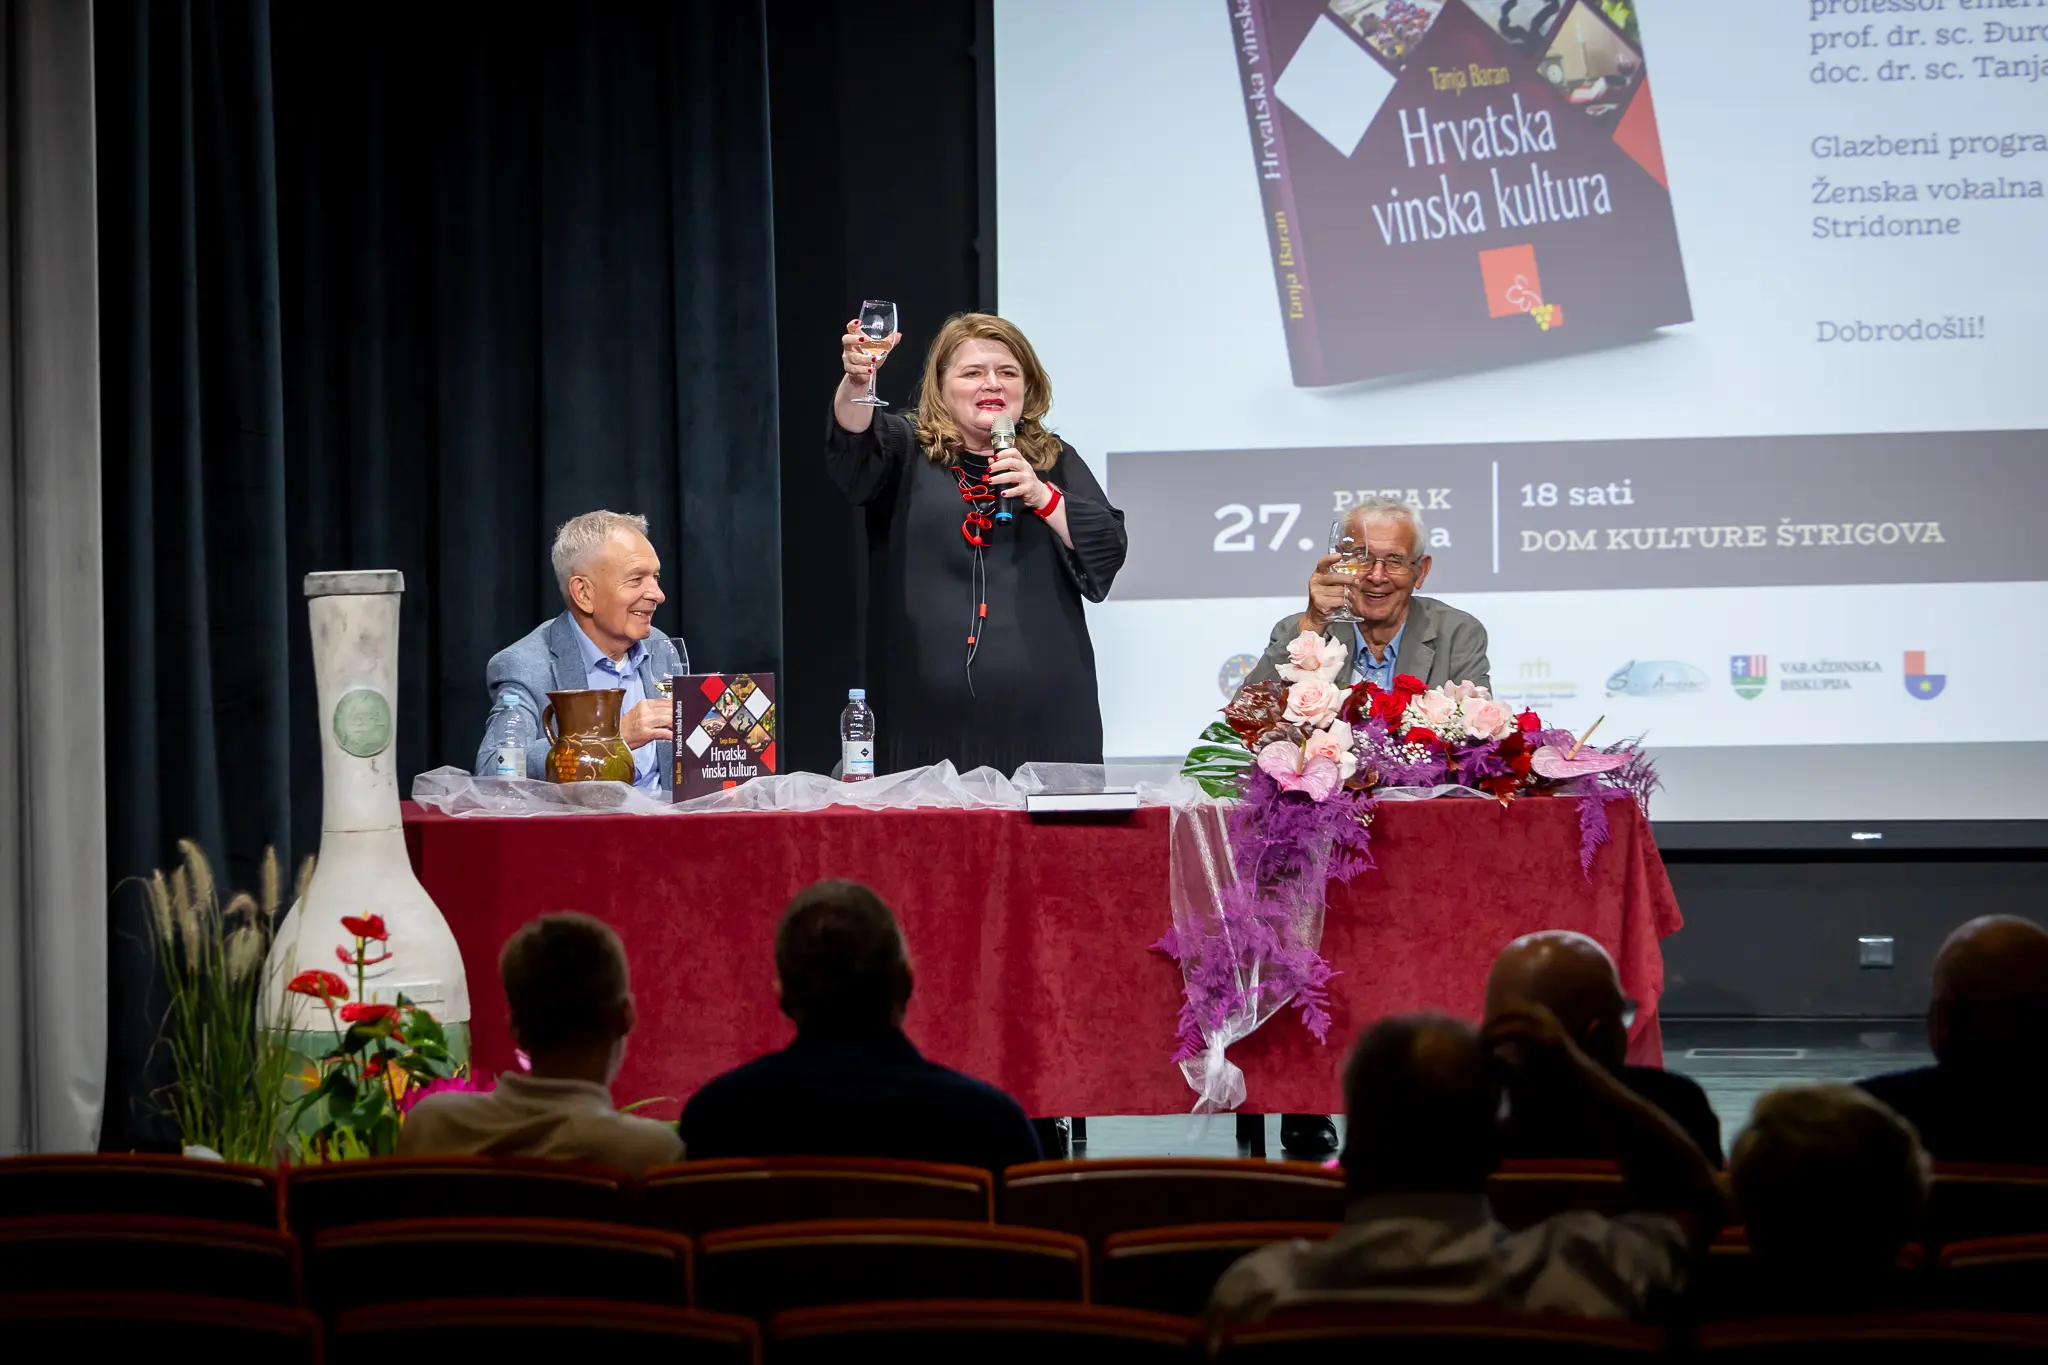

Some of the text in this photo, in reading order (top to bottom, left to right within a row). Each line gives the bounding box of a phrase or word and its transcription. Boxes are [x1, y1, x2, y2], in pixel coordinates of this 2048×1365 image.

[1809, 0, 1946, 21] professor
[1810, 25, 1878, 55] prof.
[1887, 25, 1926, 46] dr.
[1935, 27, 1974, 45] sc.
[1427, 63, 1510, 96] Tanja Baran
[1810, 62, 1868, 83] doc.
[1877, 60, 1916, 81] dr.
[1925, 61, 1964, 80] sc.
[1235, 0, 1281, 179] Hrvatska vinsk
[1398, 93, 1557, 168] Hrvatska
[1811, 133, 2048, 160] Glazbeni progra
[1811, 176, 2045, 204] Ženska vokalna
[1372, 163, 1613, 246] vinska kultura
[1274, 211, 1295, 266] Baran
[1812, 214, 1961, 239] Stridonne
[1816, 315, 1985, 343] Dobrodošli!
[1520, 479, 1635, 507] 18 sati
[1213, 503, 1314, 552] 27.
[1520, 518, 1946, 552] DOM KULTURE ŠTRIGOVA
[710, 745, 747, 762] Hrvatska
[702, 761, 758, 779] vinska kultura
